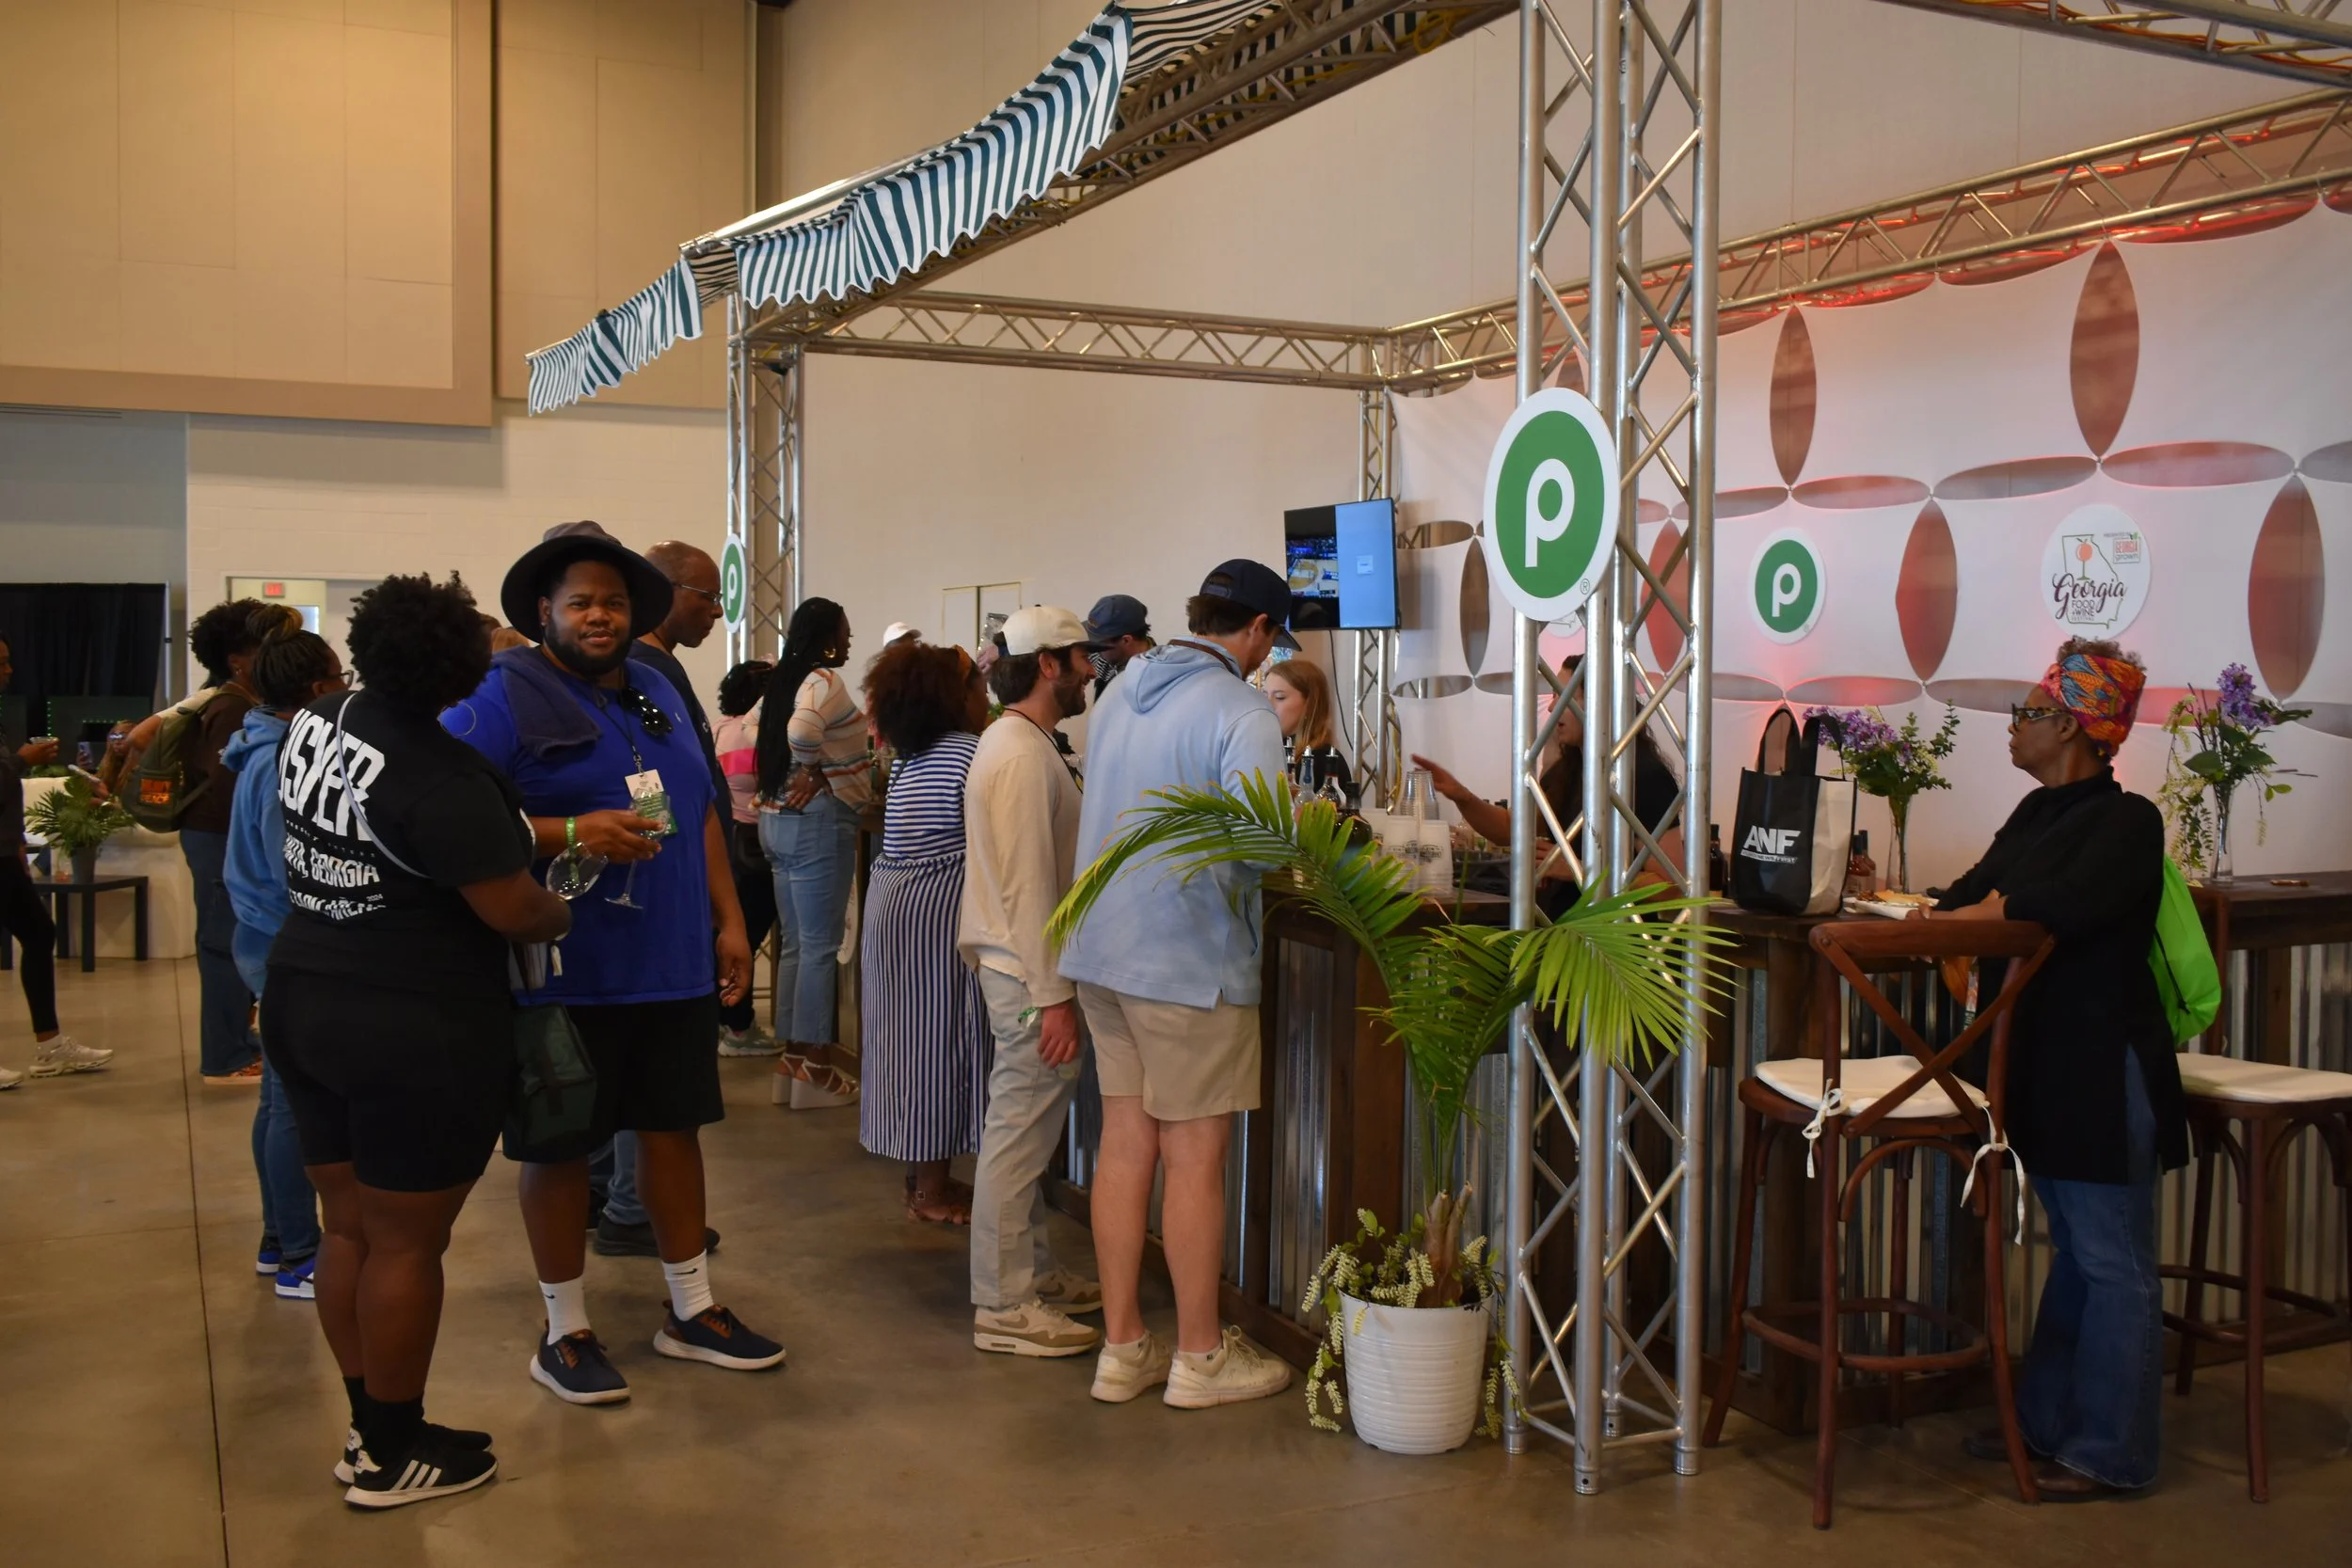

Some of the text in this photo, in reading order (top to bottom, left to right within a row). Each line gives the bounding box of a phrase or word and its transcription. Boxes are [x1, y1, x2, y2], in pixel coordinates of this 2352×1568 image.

[2052, 573, 2128, 620] Georgia
[2072, 599, 2095, 609] FOOD
[1742, 825, 1802, 855] ANF
[310, 847, 381, 888] GEORGIA
[366, 894, 384, 903] 2024
